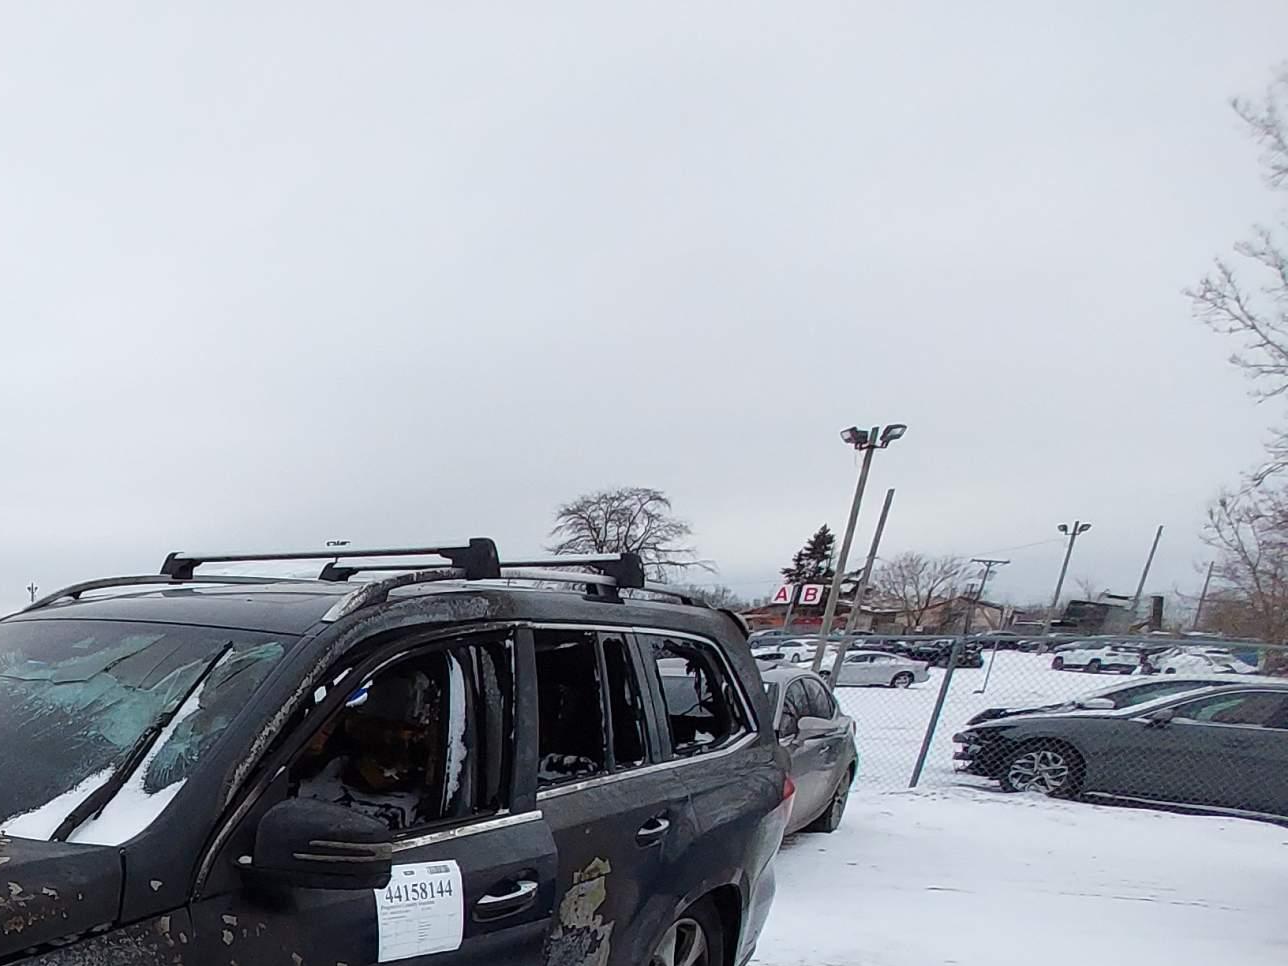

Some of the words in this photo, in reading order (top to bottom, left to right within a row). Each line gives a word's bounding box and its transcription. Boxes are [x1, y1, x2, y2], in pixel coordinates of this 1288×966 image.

[775, 587, 787, 601] A
[804, 587, 818, 601] B
[385, 880, 452, 903] 44158144
